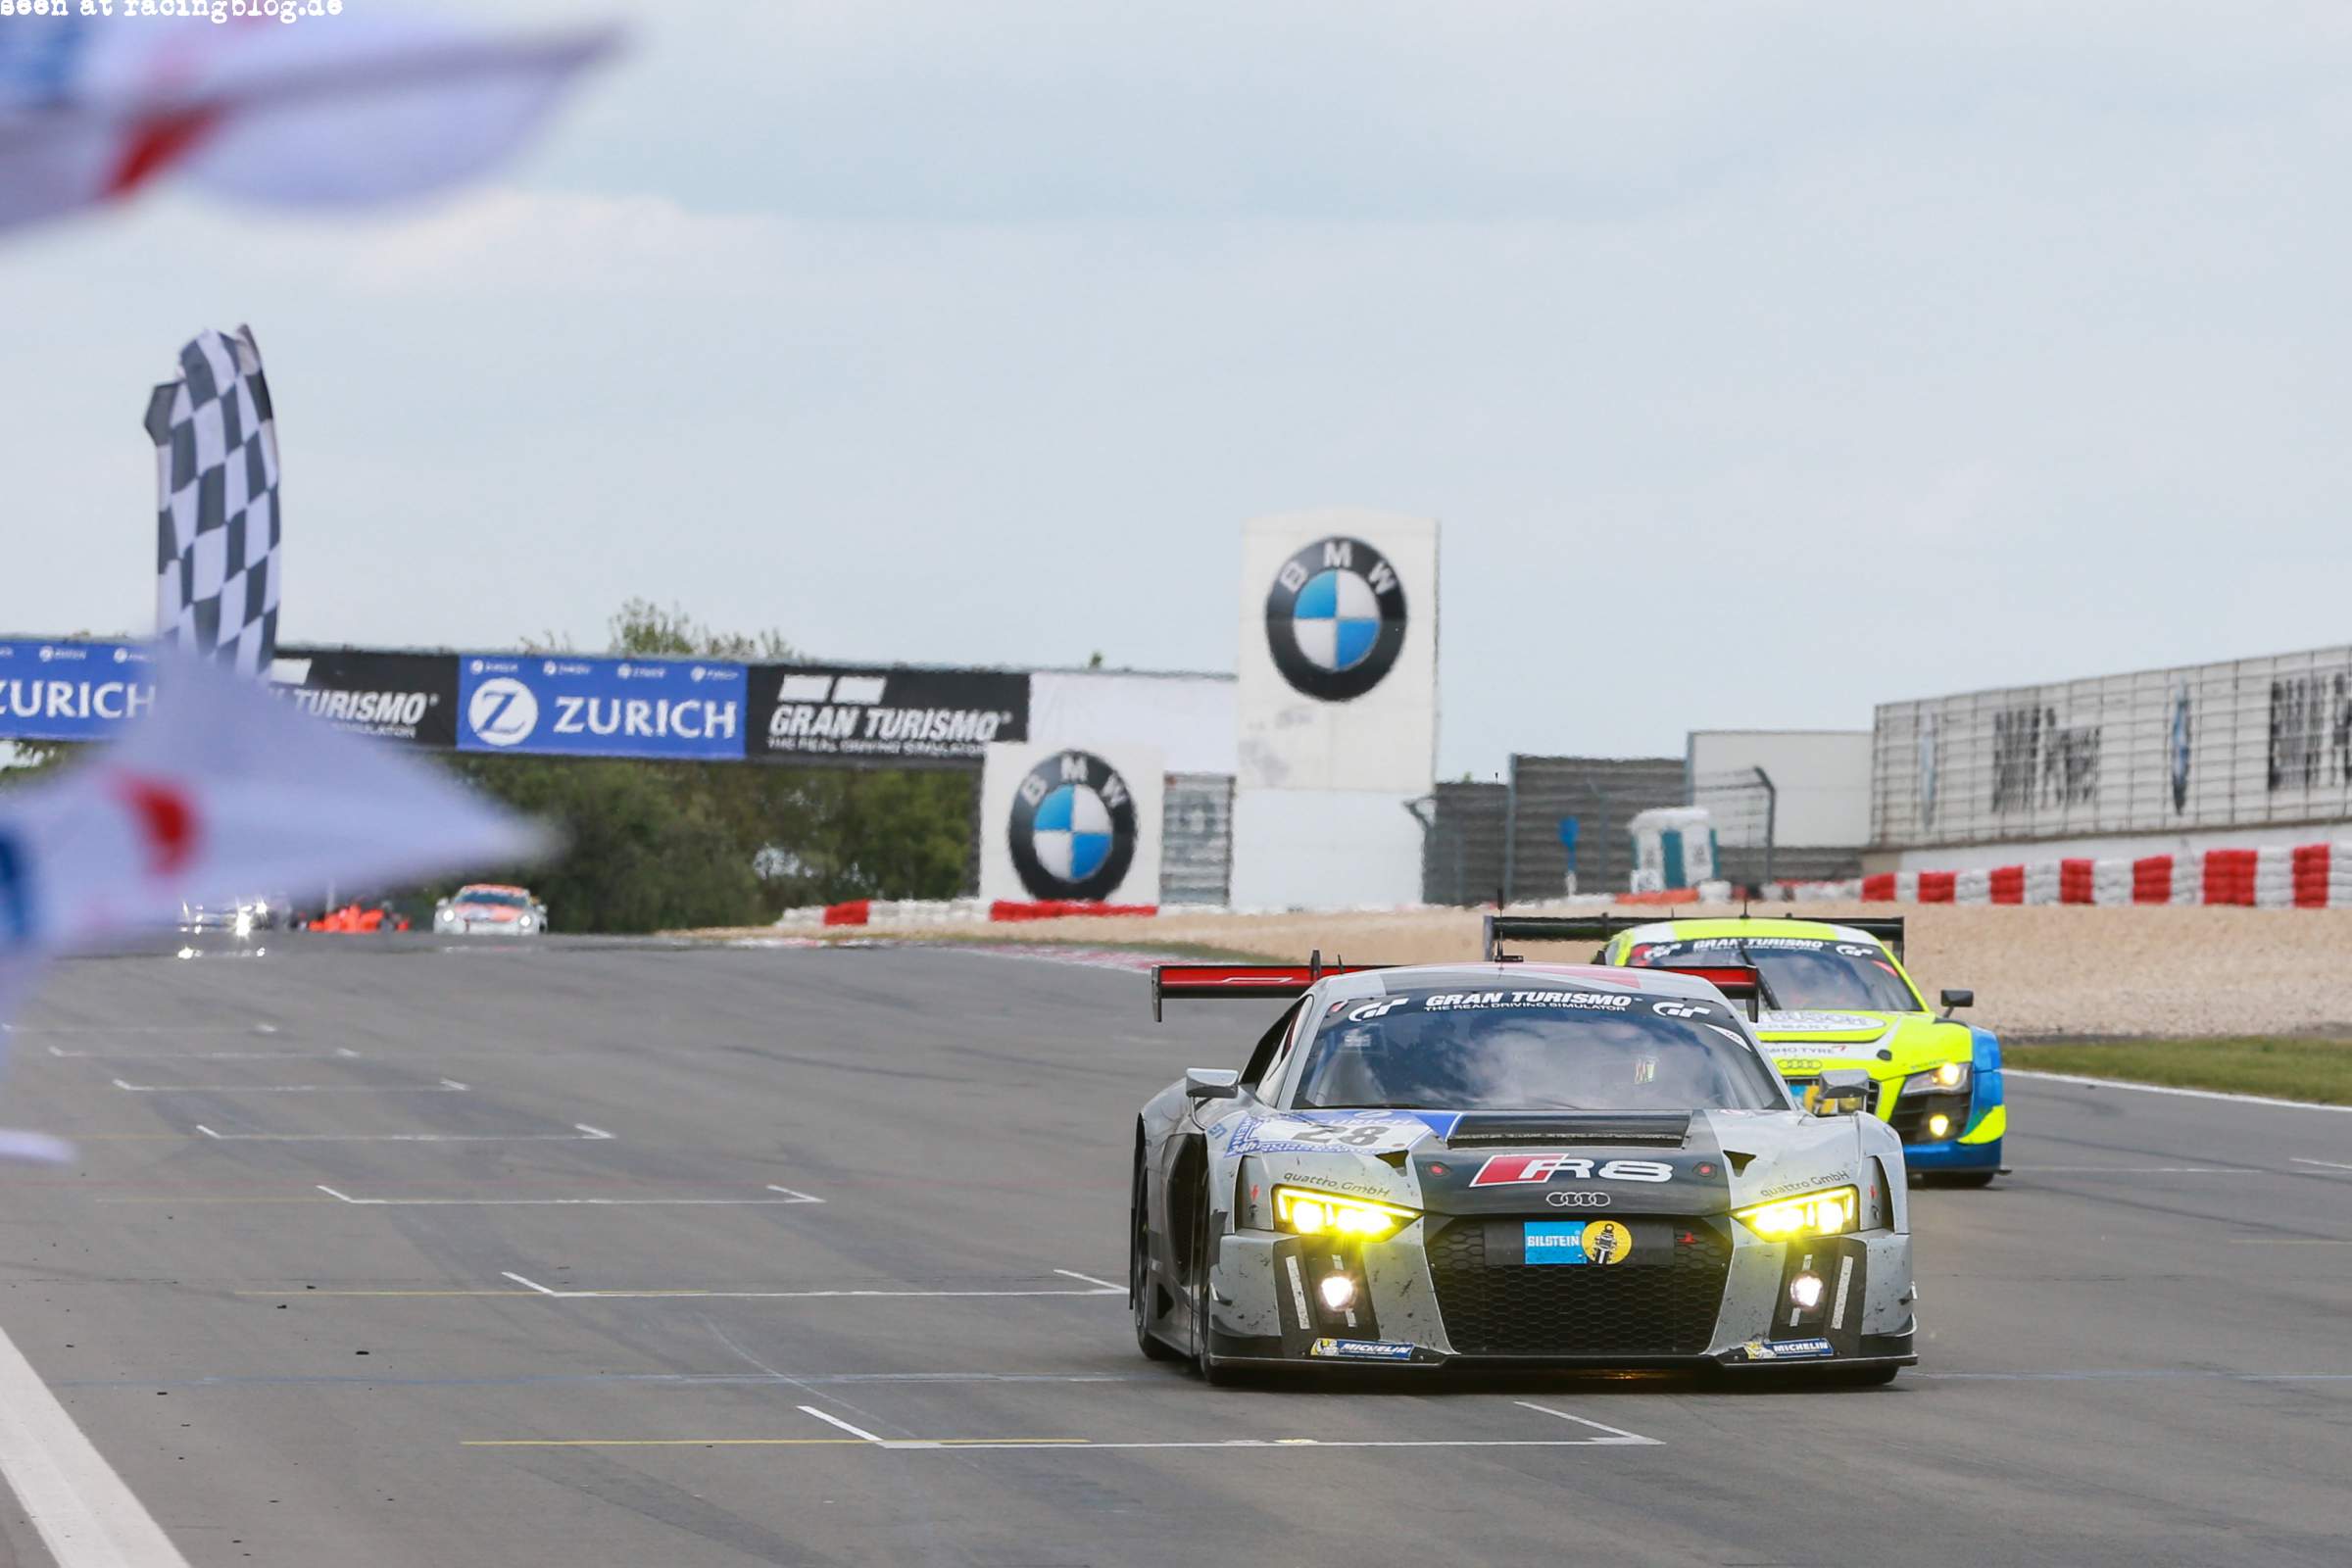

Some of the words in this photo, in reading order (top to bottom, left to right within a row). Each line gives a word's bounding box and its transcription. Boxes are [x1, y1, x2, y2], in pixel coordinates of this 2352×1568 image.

[1280, 541, 1397, 594] BMW
[294, 687, 428, 725] TURISMO
[553, 695, 738, 739] ZURICH
[768, 704, 861, 739] GRAN
[862, 707, 1002, 742] TURISMO
[1022, 754, 1127, 808] BMW
[1747, 937, 1824, 950] TURISMO
[1425, 992, 1504, 1006] GRAN
[1511, 991, 1632, 1006] TURISMO
[1548, 1003, 1626, 1012] SIMULATOR
[1292, 1125, 1391, 1147] 28
[1518, 1158, 1674, 1183] R8
[1284, 1172, 1339, 1188] quattro
[1341, 1181, 1390, 1197] GmbH
[1760, 1181, 1811, 1198] quattro
[1810, 1170, 1850, 1186] GmbH
[1527, 1235, 1580, 1248] BILSTEIN
[1341, 1343, 1411, 1353] MICHELIN
[1773, 1342, 1829, 1352] MICHELIN
